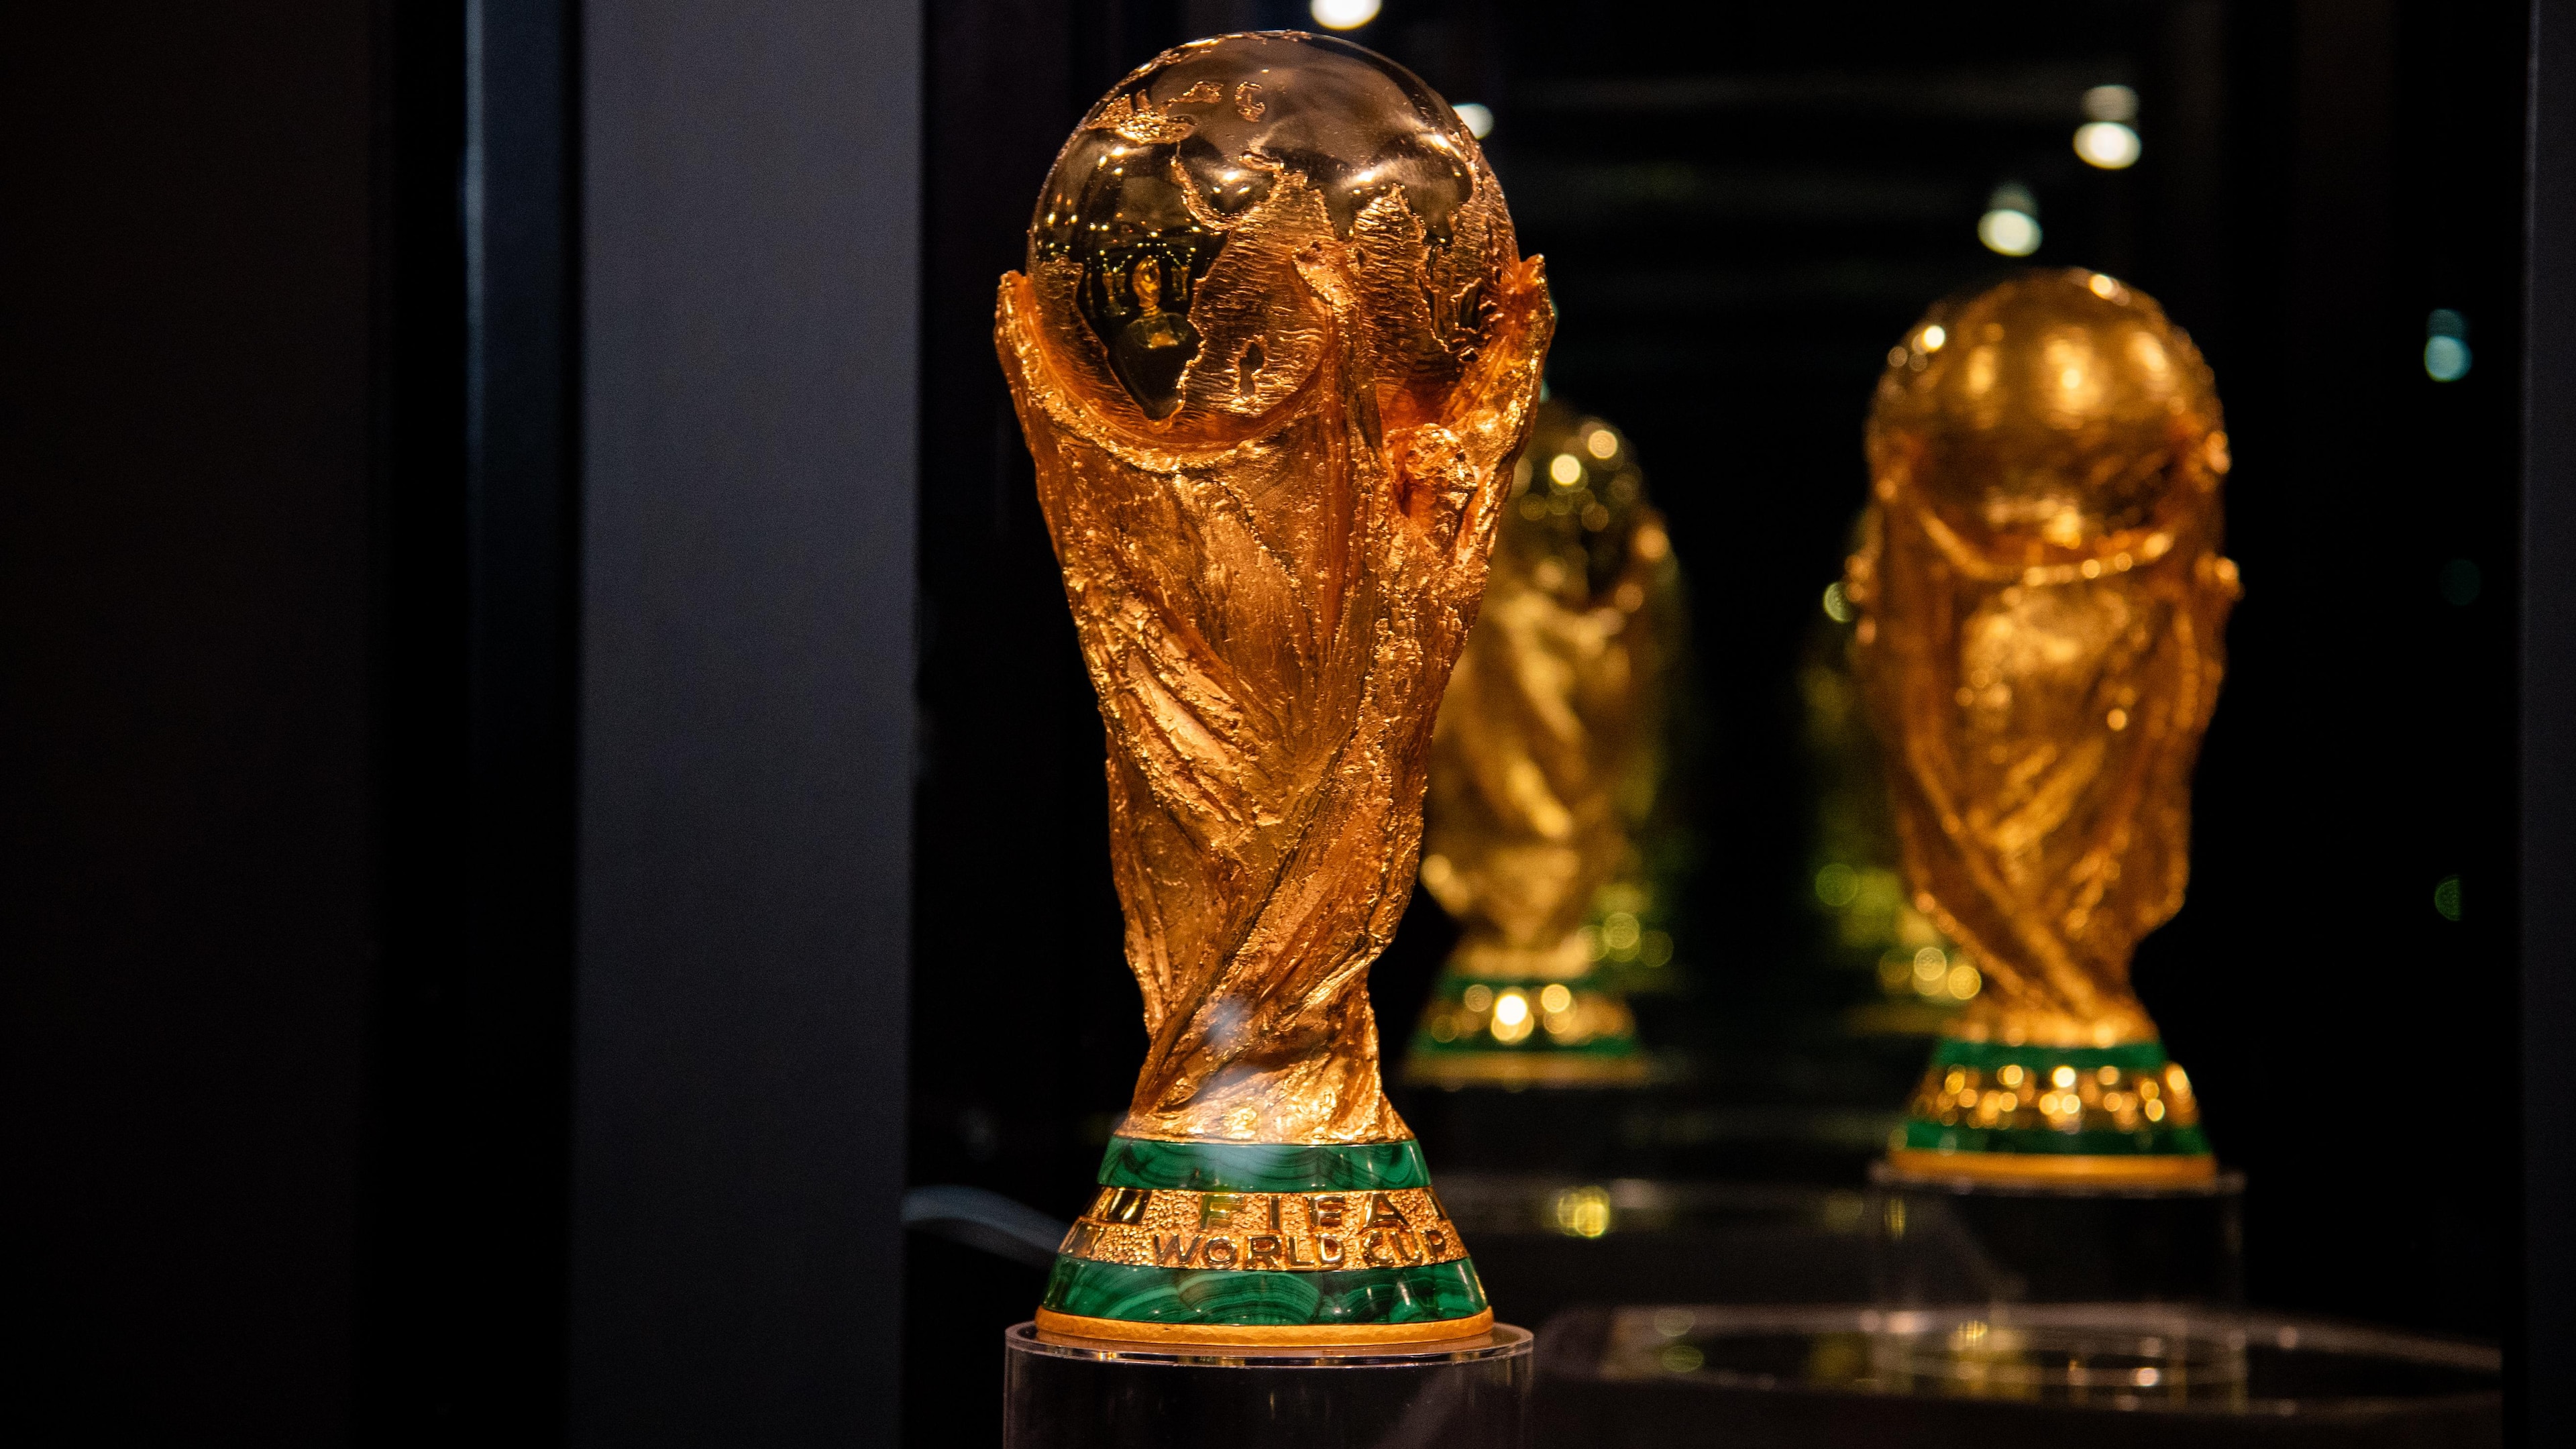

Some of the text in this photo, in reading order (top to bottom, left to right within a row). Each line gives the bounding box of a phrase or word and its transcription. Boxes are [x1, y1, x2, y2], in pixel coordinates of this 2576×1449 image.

[1199, 1192, 1409, 1232] FIFA
[1154, 1229, 1446, 1270] WORLD CUP
